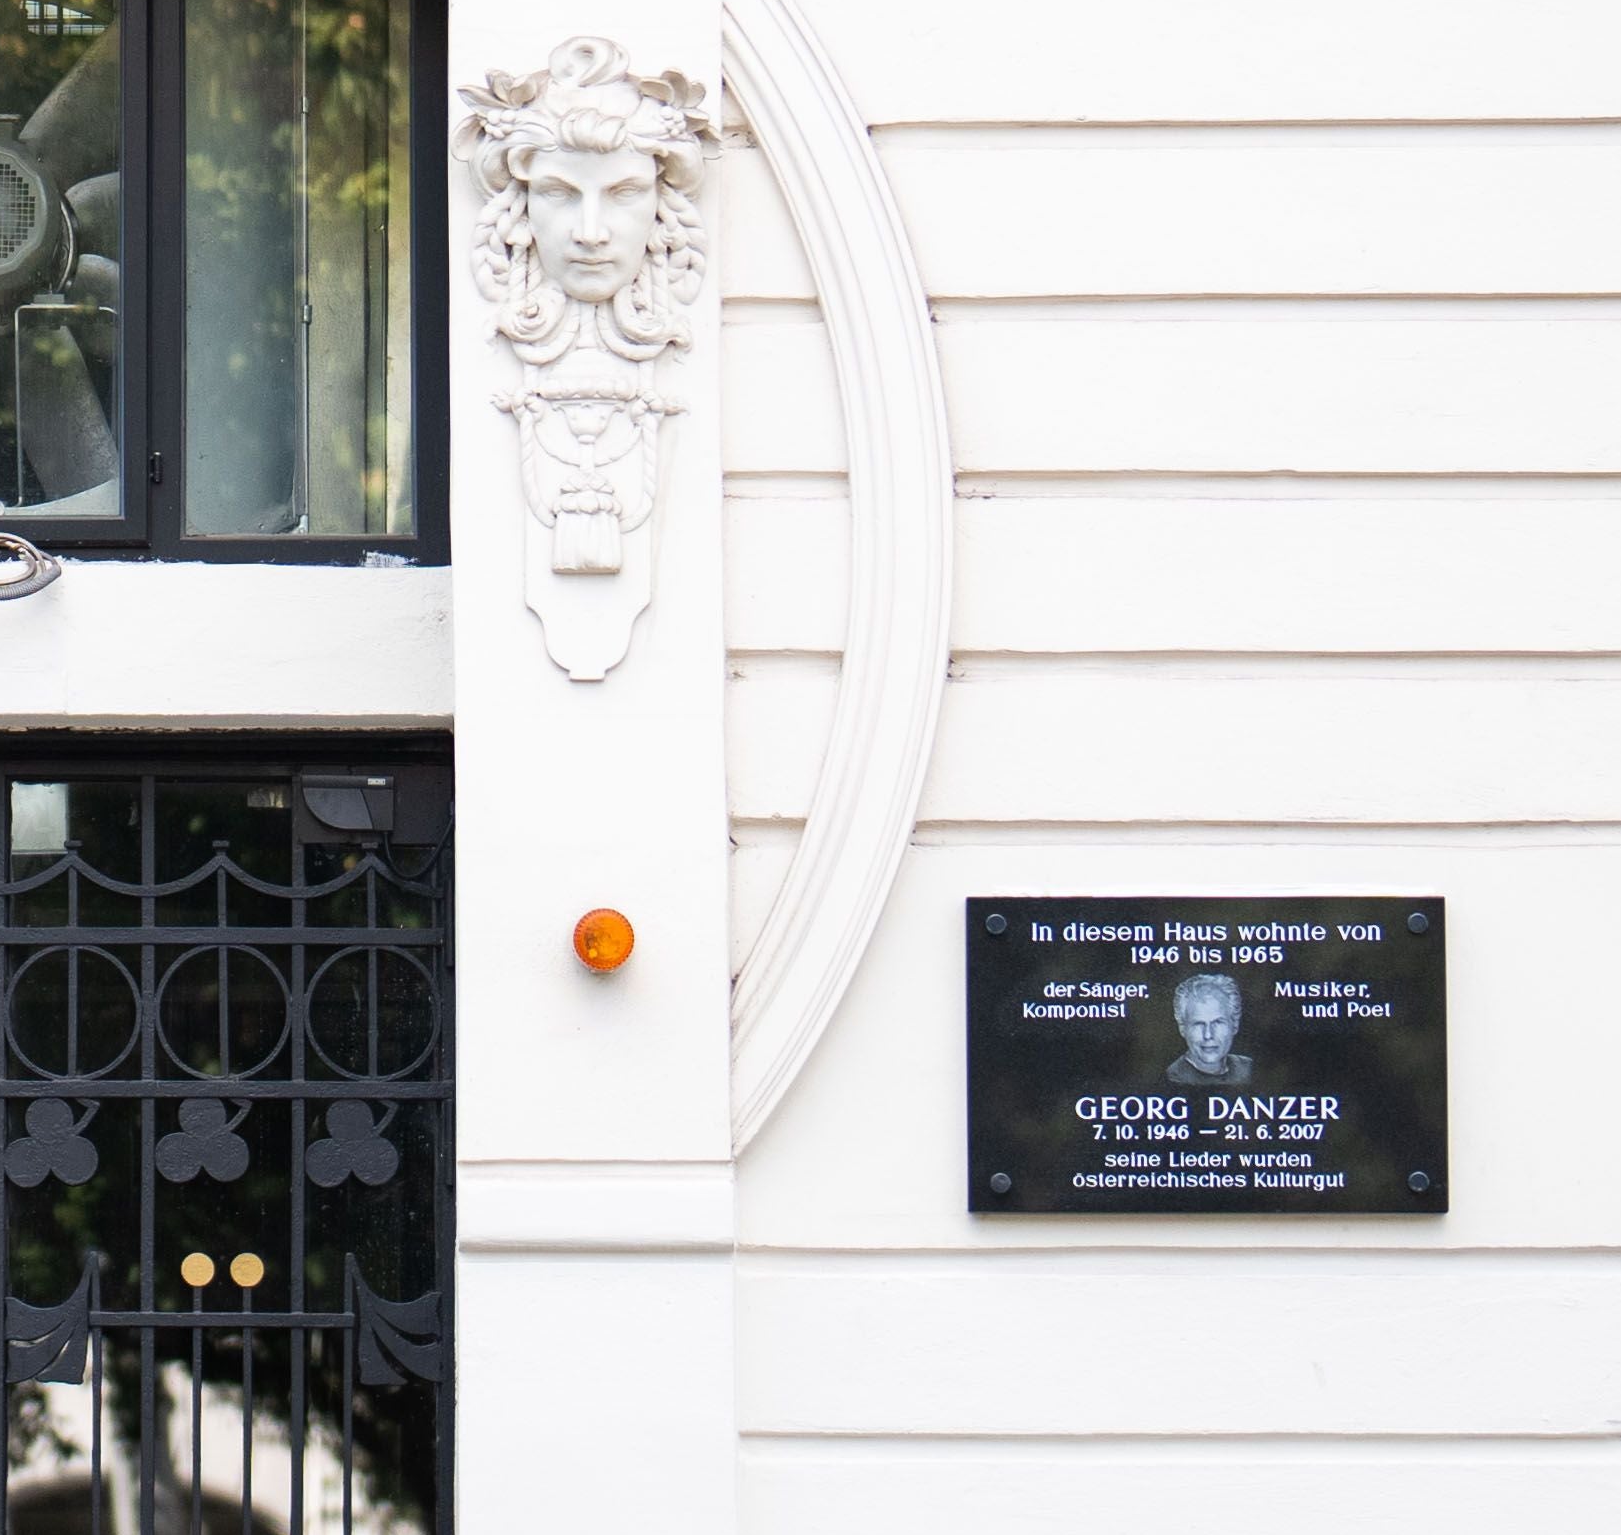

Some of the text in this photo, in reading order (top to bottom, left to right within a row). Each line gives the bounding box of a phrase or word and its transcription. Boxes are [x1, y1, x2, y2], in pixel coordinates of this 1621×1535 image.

[1031, 922, 1382, 942] In diesem Haus wohnte von
[1130, 946, 1283, 964] 1946 bis 1965
[1043, 982, 1075, 998] der
[1023, 1002, 1126, 1020] Komponist
[1301, 1002, 1391, 1018] und Poet
[1075, 1096, 1340, 1121] GEORG DANZER
[1092, 1124, 1108, 1141] 7.
[1114, 1124, 1140, 1141] 10.
[1147, 1124, 1190, 1141] 1946
[1224, 1124, 1250, 1141] 21.
[1256, 1124, 1274, 1141] 6.
[1278, 1124, 1324, 1141] 2007
[1104, 1152, 1312, 1168] seine Lieder wurden
[1072, 1171, 1344, 1192] österreichisches Kulturgut
